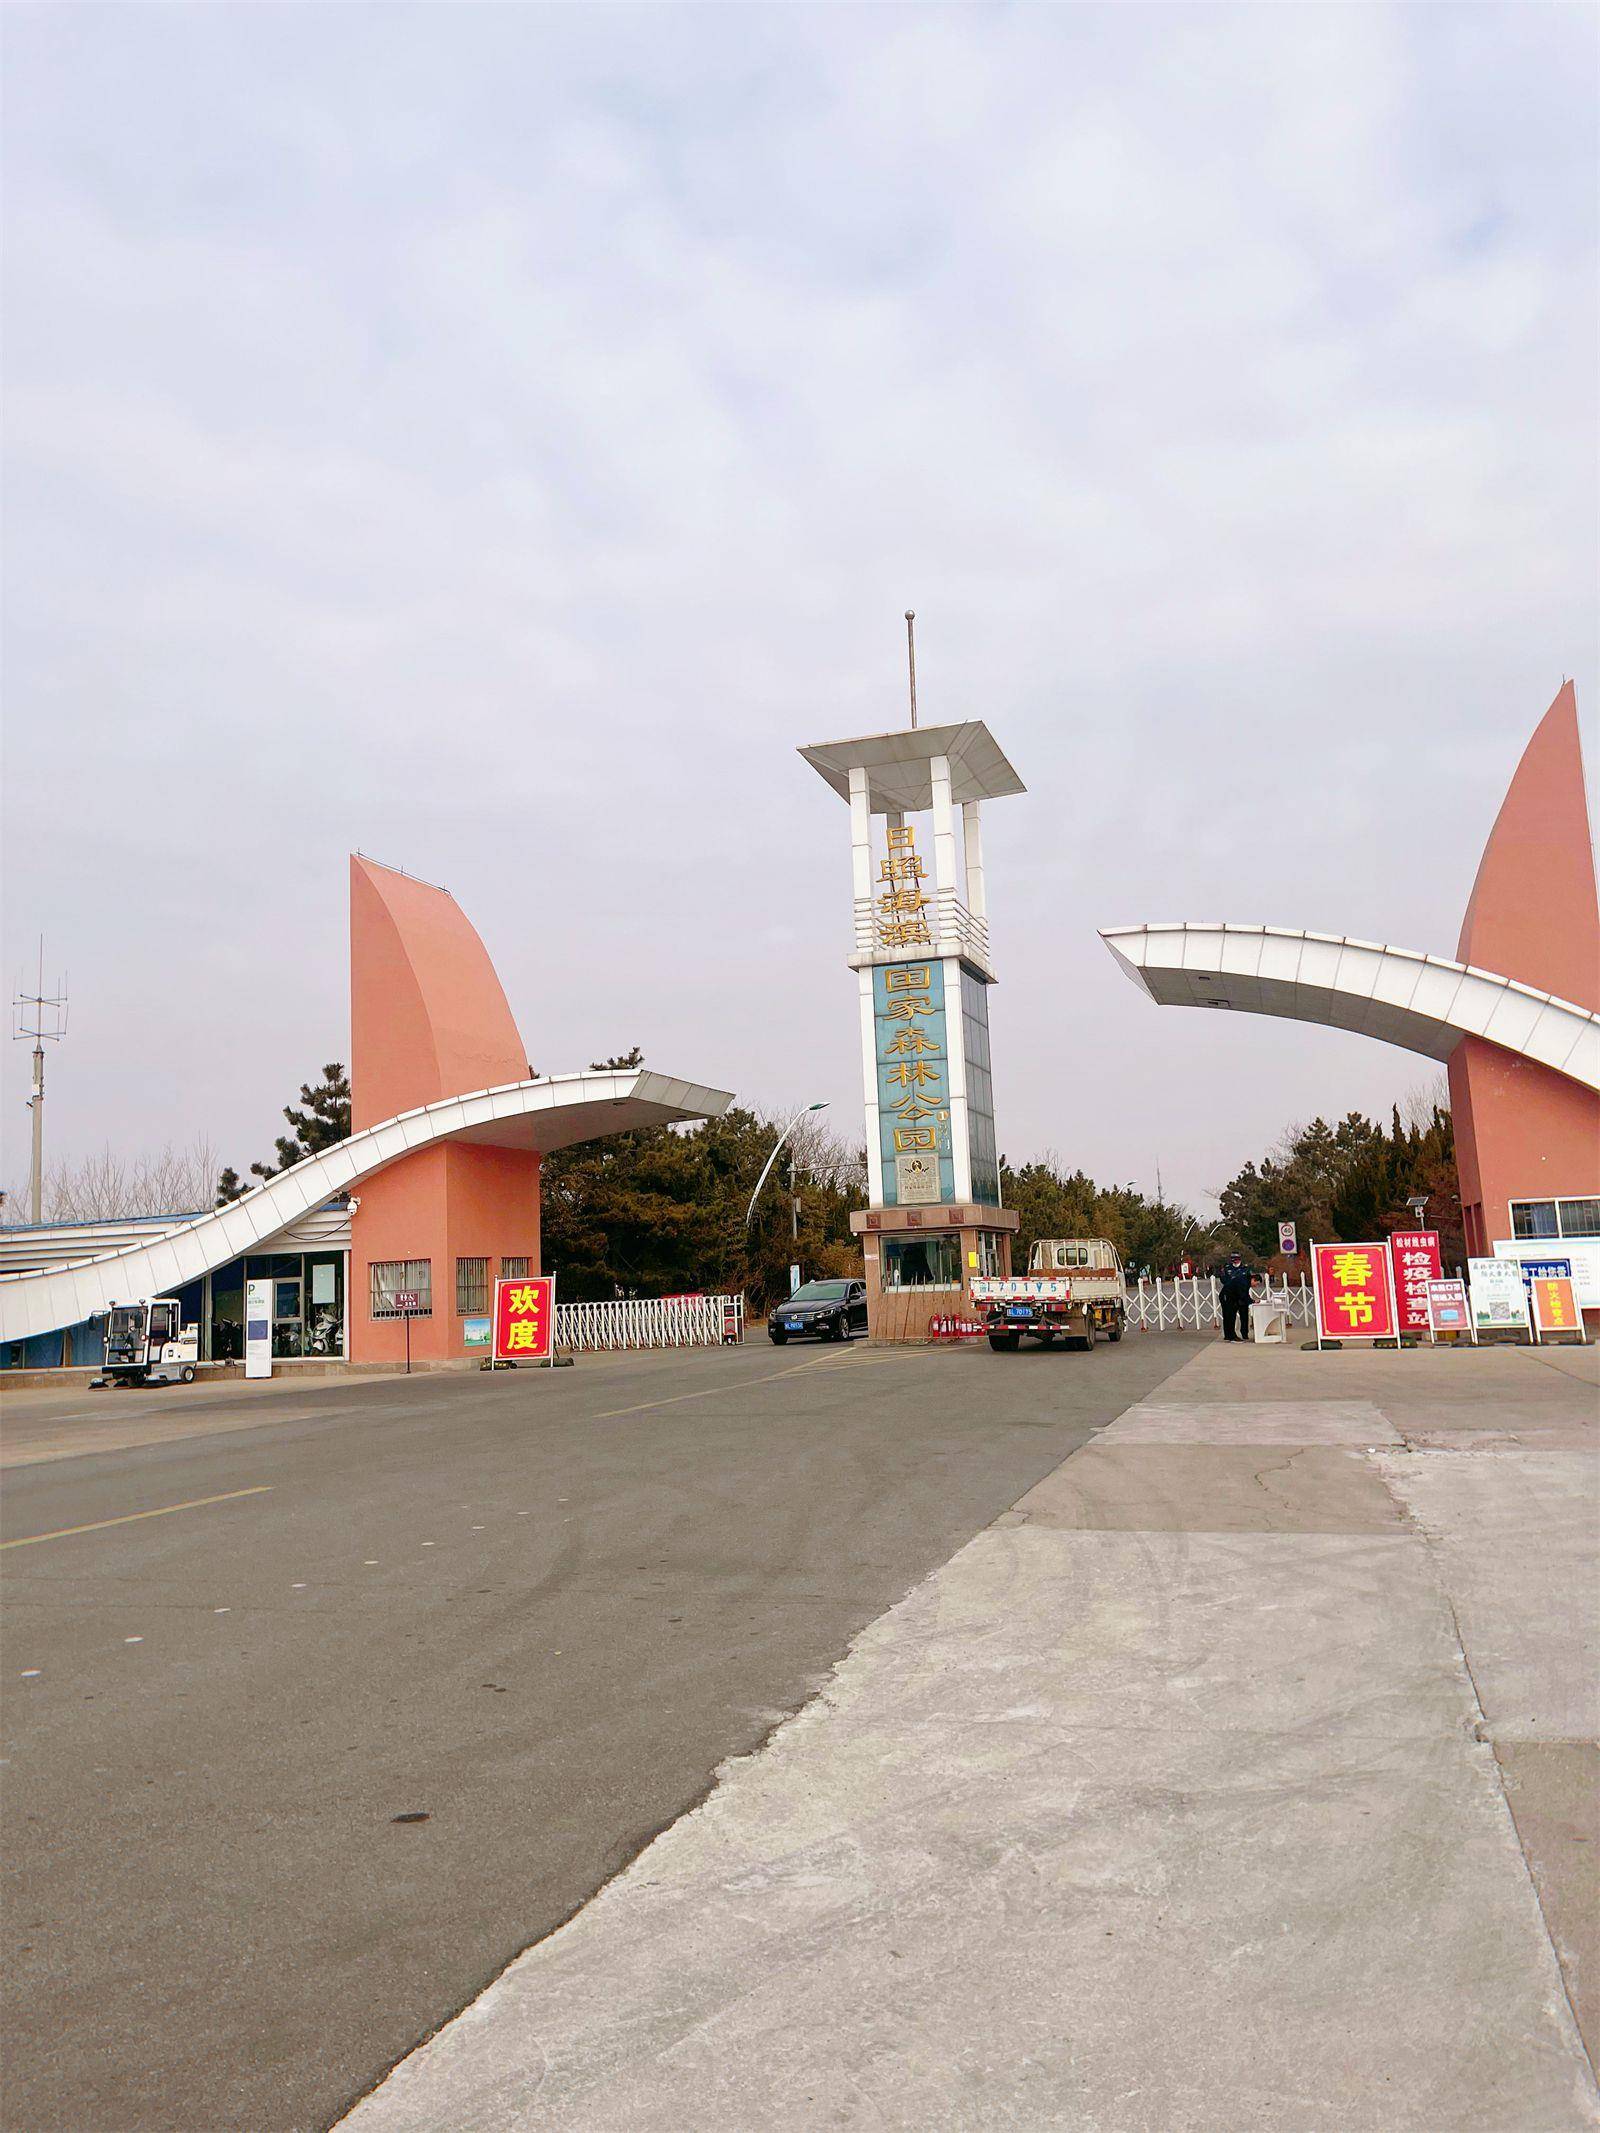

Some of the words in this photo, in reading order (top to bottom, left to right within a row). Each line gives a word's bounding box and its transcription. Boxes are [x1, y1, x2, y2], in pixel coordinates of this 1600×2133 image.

[876, 826, 931, 946] 日照海滨
[884, 966, 943, 1152] 国家森林公园
[506, 1285, 540, 1350] 欢度
[1332, 1251, 1376, 1327] 春节
